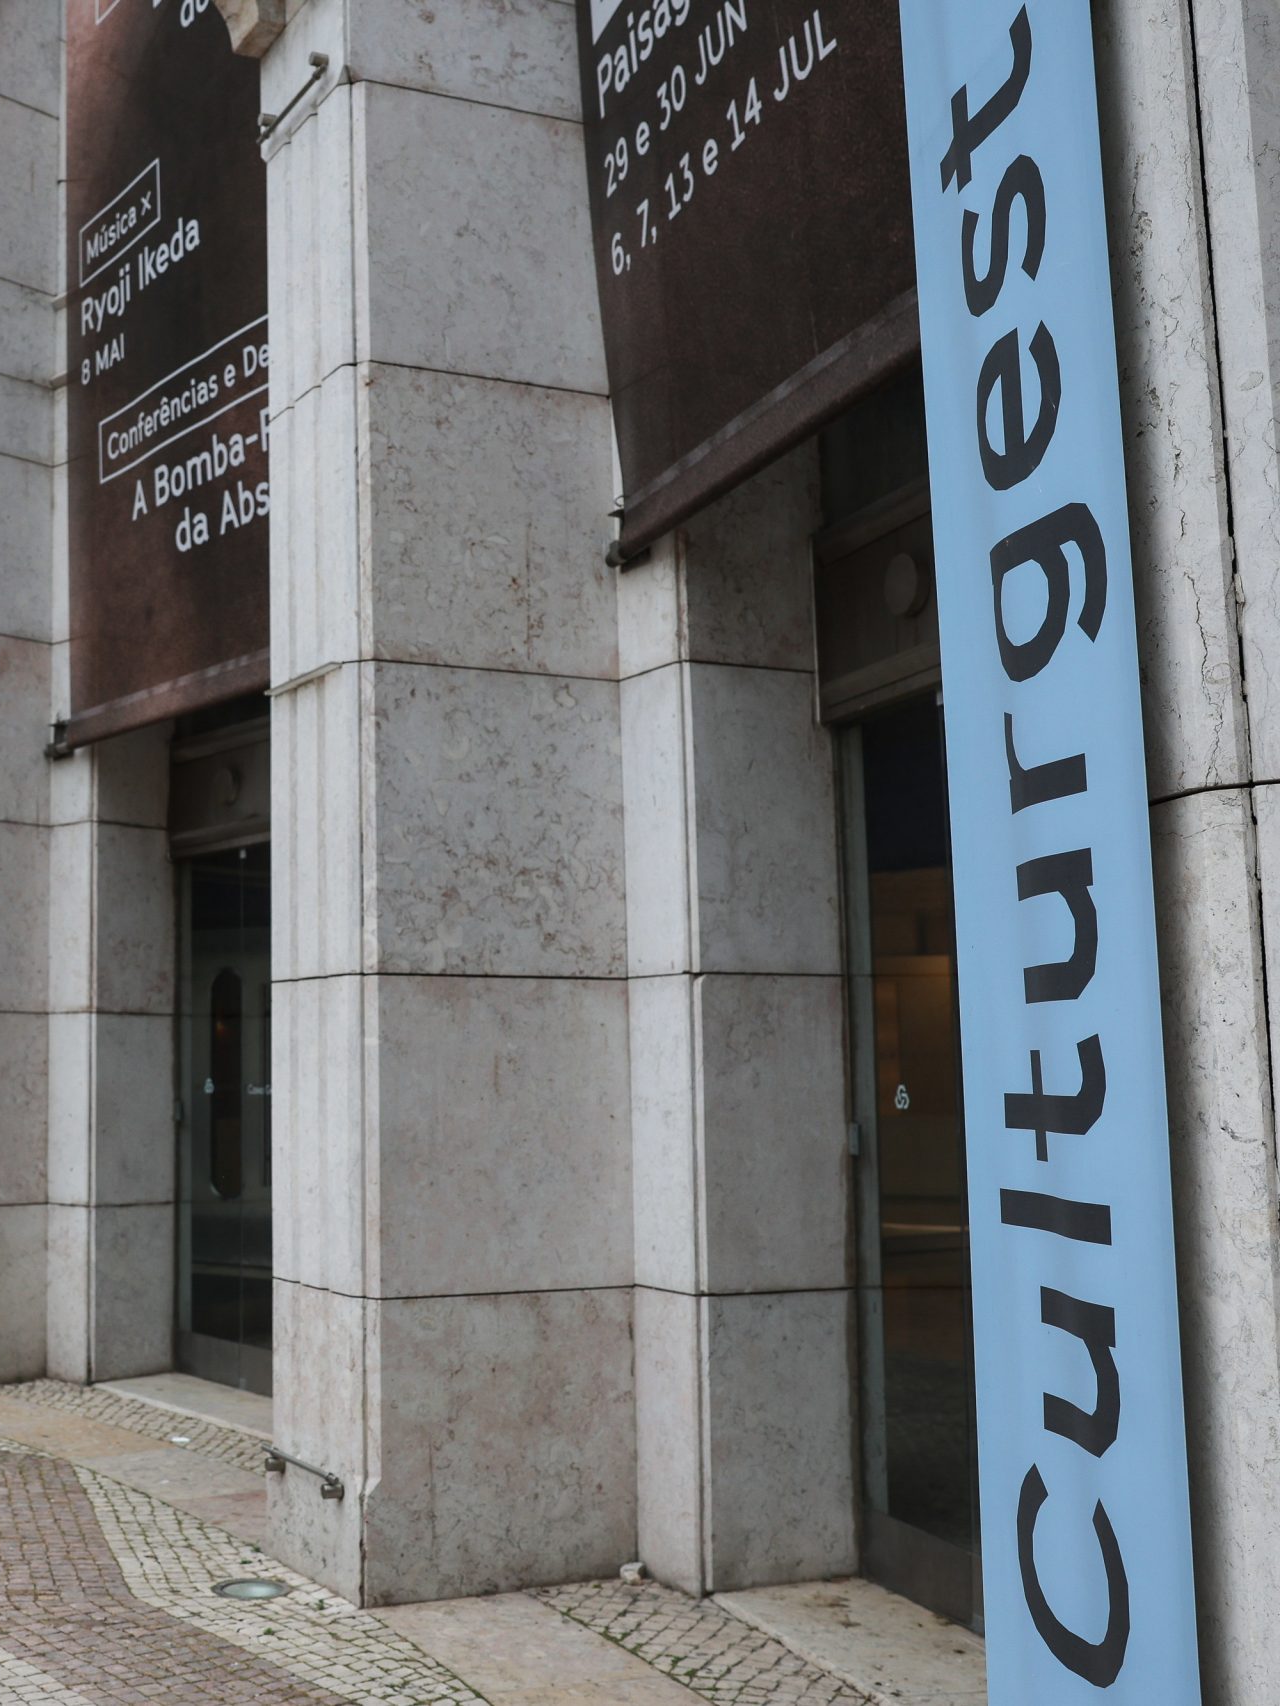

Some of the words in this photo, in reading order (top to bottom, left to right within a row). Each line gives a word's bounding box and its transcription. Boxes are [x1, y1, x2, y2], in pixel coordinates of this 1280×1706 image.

[604, 136, 628, 199] 29
[635, 121, 650, 155] e
[656, 64, 687, 131] 30
[695, 0, 748, 85] JUN
[611, 231, 631, 275] 6,
[636, 199, 657, 248] 7,
[664, 151, 694, 220] 13
[702, 138, 718, 176] e
[726, 76, 762, 151] 14
[773, 9, 837, 102] JUL
[81, 262, 131, 336] Ryoji
[138, 217, 201, 291] Ikeda
[86, 206, 137, 265] Música
[81, 358, 91, 386] 8
[95, 333, 125, 376] MAI
[107, 373, 218, 460] Conferências
[223, 363, 236, 388] e
[132, 479, 148, 521] A
[175, 506, 210, 553] da
[939, 2, 1130, 1690] Culturgest
